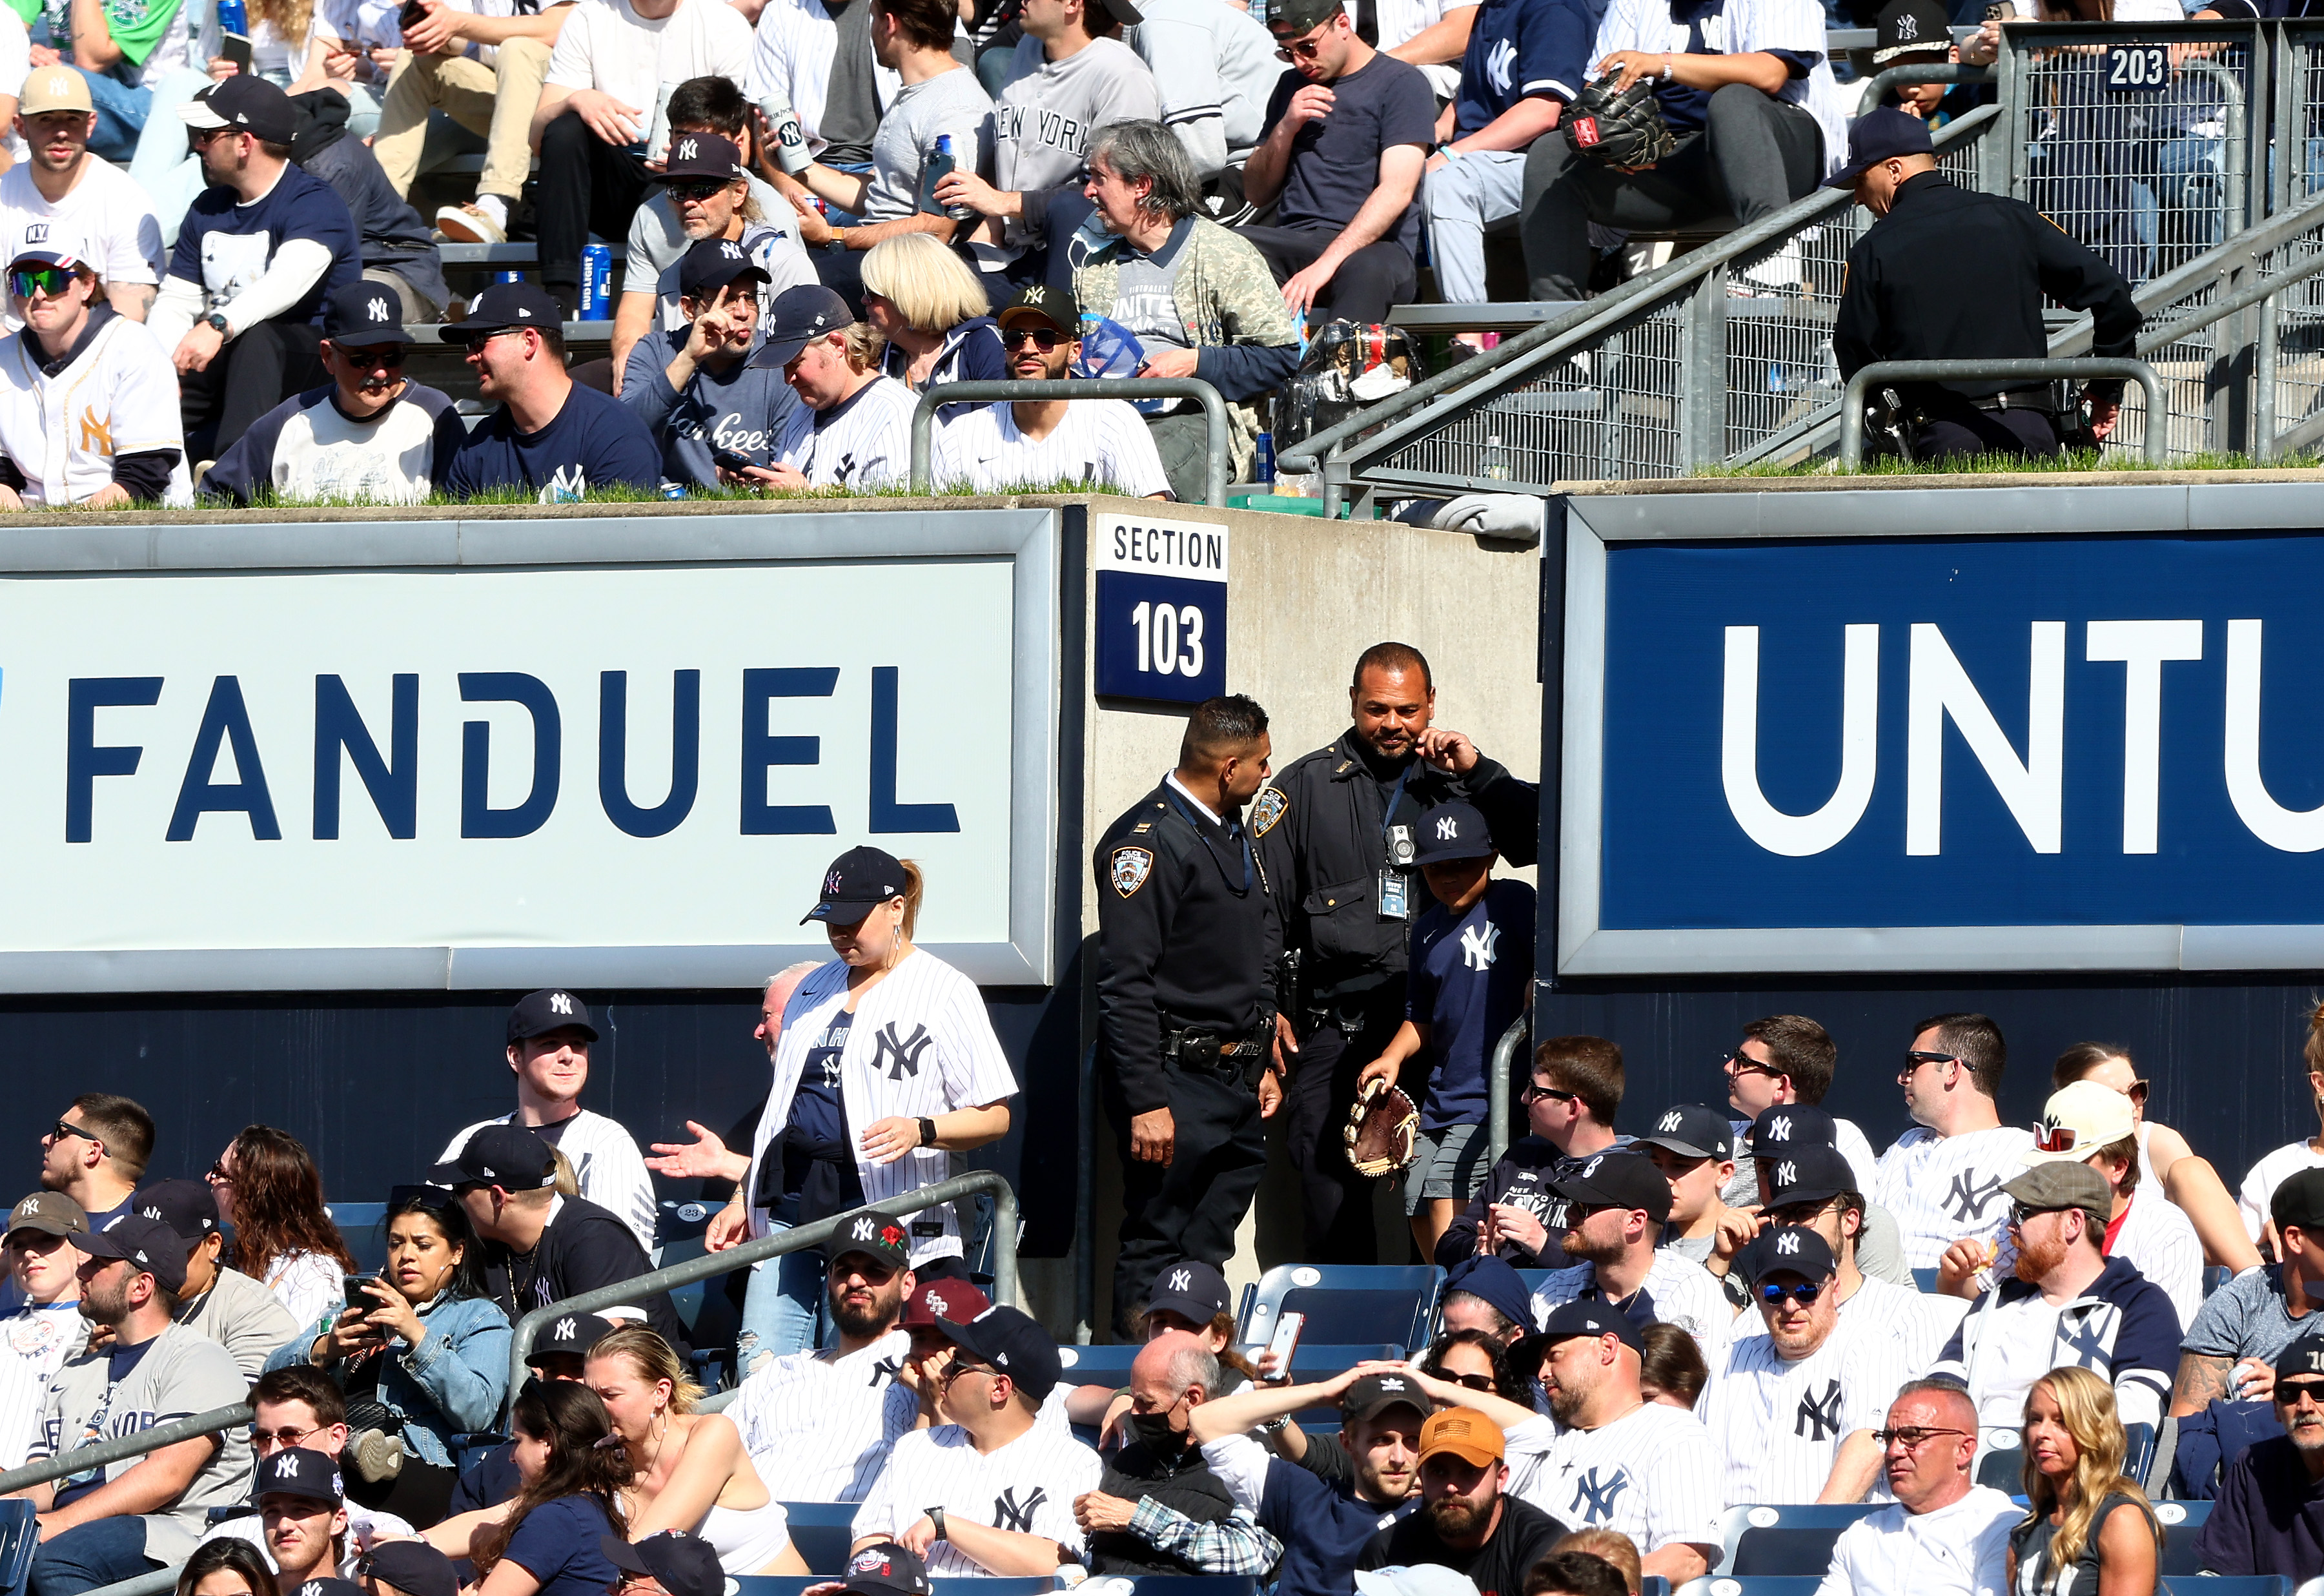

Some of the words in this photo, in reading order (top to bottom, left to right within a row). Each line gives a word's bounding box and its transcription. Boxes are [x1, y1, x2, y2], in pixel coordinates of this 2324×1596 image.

[2110, 49, 2163, 86] 203
[49, 76, 68, 96] NY
[678, 139, 697, 160] NY
[27, 225, 47, 241] N.Y.
[720, 241, 744, 260] NY
[583, 256, 593, 287] LIGHT
[582, 287, 591, 311] BUD
[1023, 286, 1045, 304] NY
[368, 297, 389, 322] NY
[1114, 526, 1222, 569] SECTION
[1132, 601, 1204, 678] 103
[66, 666, 961, 843] FANDUEL
[1436, 815, 1457, 839] NY
[1460, 921, 1501, 971] NY
[550, 993, 573, 1015] NY
[872, 1021, 933, 1080] NY
[1658, 1111, 1682, 1132] NY
[1768, 1115, 1792, 1141] NY
[1778, 1160, 1797, 1186] NY
[1509, 1185, 1530, 1194] NEW
[1941, 1167, 2003, 1222] NY
[22, 1198, 39, 1216] NY
[685, 1209, 699, 1218] 23
[852, 1217, 875, 1241] NY
[1777, 1232, 1800, 1254] NY
[1168, 1269, 1192, 1291] NY
[1303, 1272, 1309, 1281] 1
[555, 1318, 576, 1340] NY
[2001, 1435, 2008, 1444] 7
[275, 1454, 299, 1478] NY
[1569, 1466, 1627, 1524] NY
[1760, 1512, 1767, 1522] 7
[2166, 1510, 2174, 1519] 9
[1722, 1585, 1729, 1594] 8
